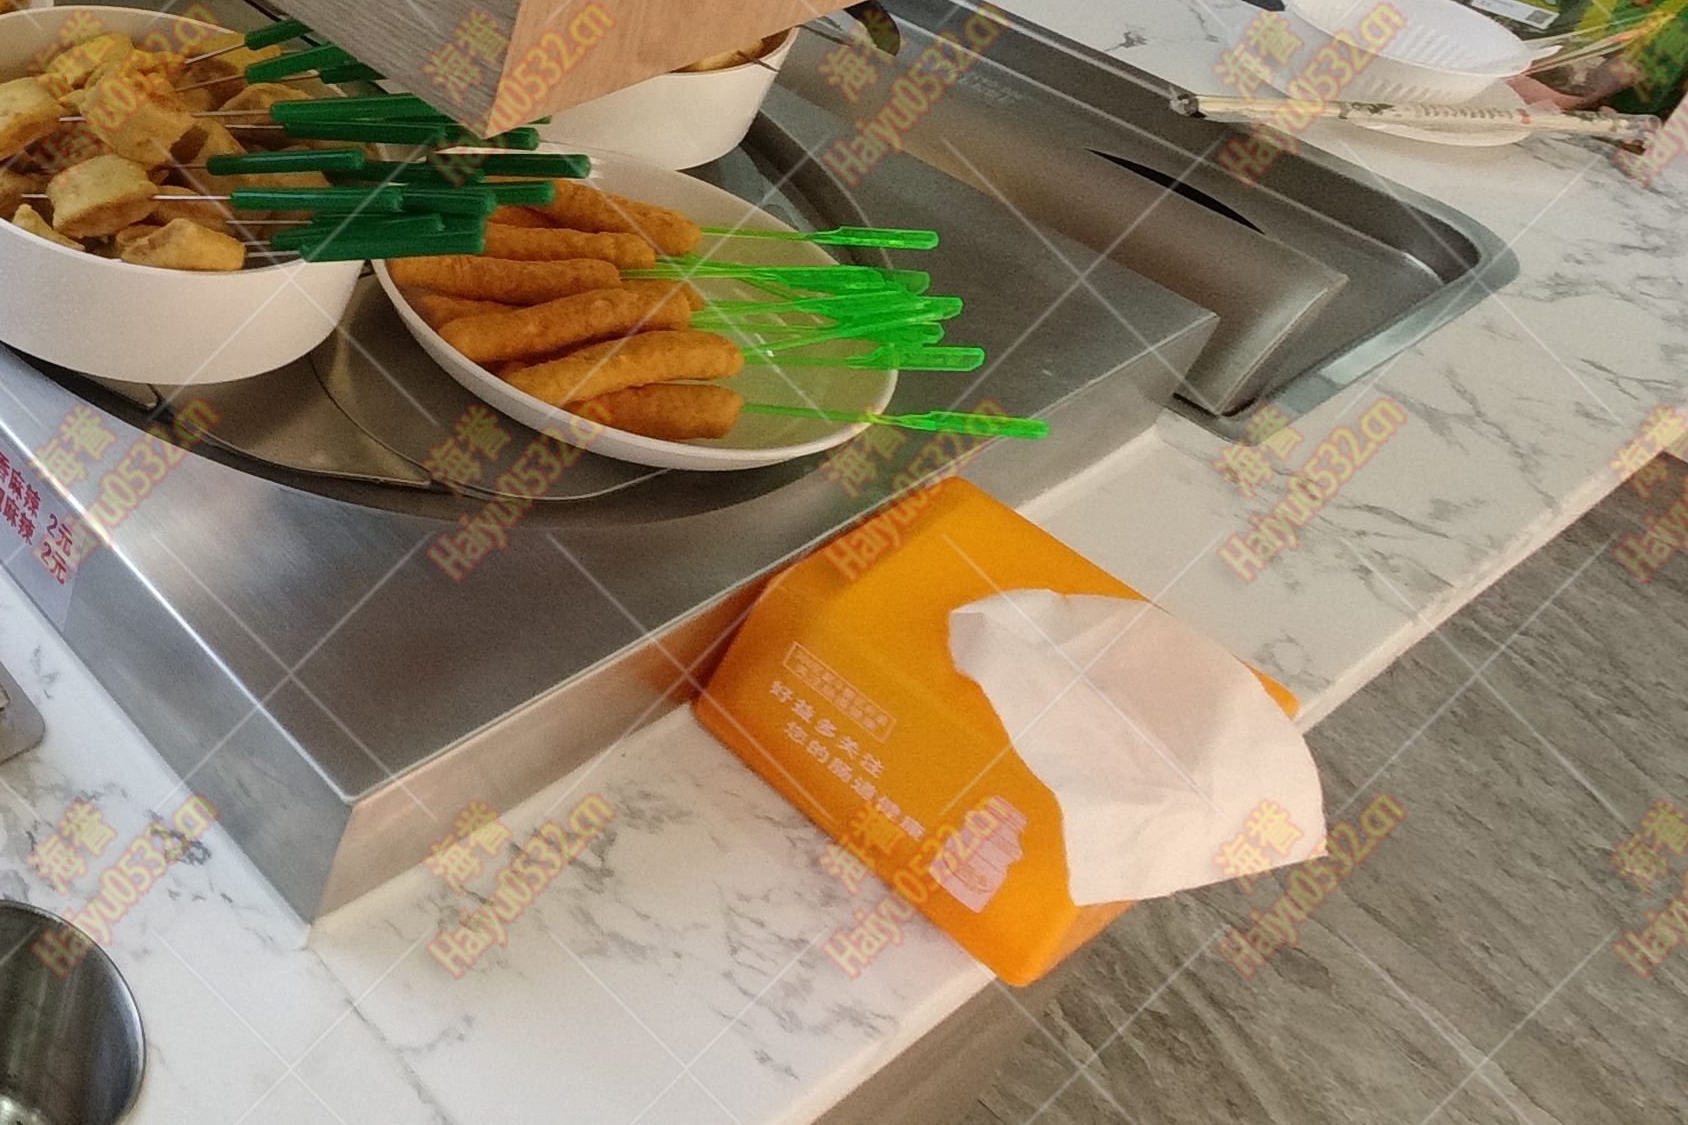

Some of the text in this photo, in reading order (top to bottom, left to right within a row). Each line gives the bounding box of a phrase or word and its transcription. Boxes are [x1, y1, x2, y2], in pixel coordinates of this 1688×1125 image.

[41, 542, 65, 585] 2元
[47, 514, 73, 557] 2元
[770, 680, 883, 778] 好益多关注
[785, 722, 925, 841] 您的肠道健康
